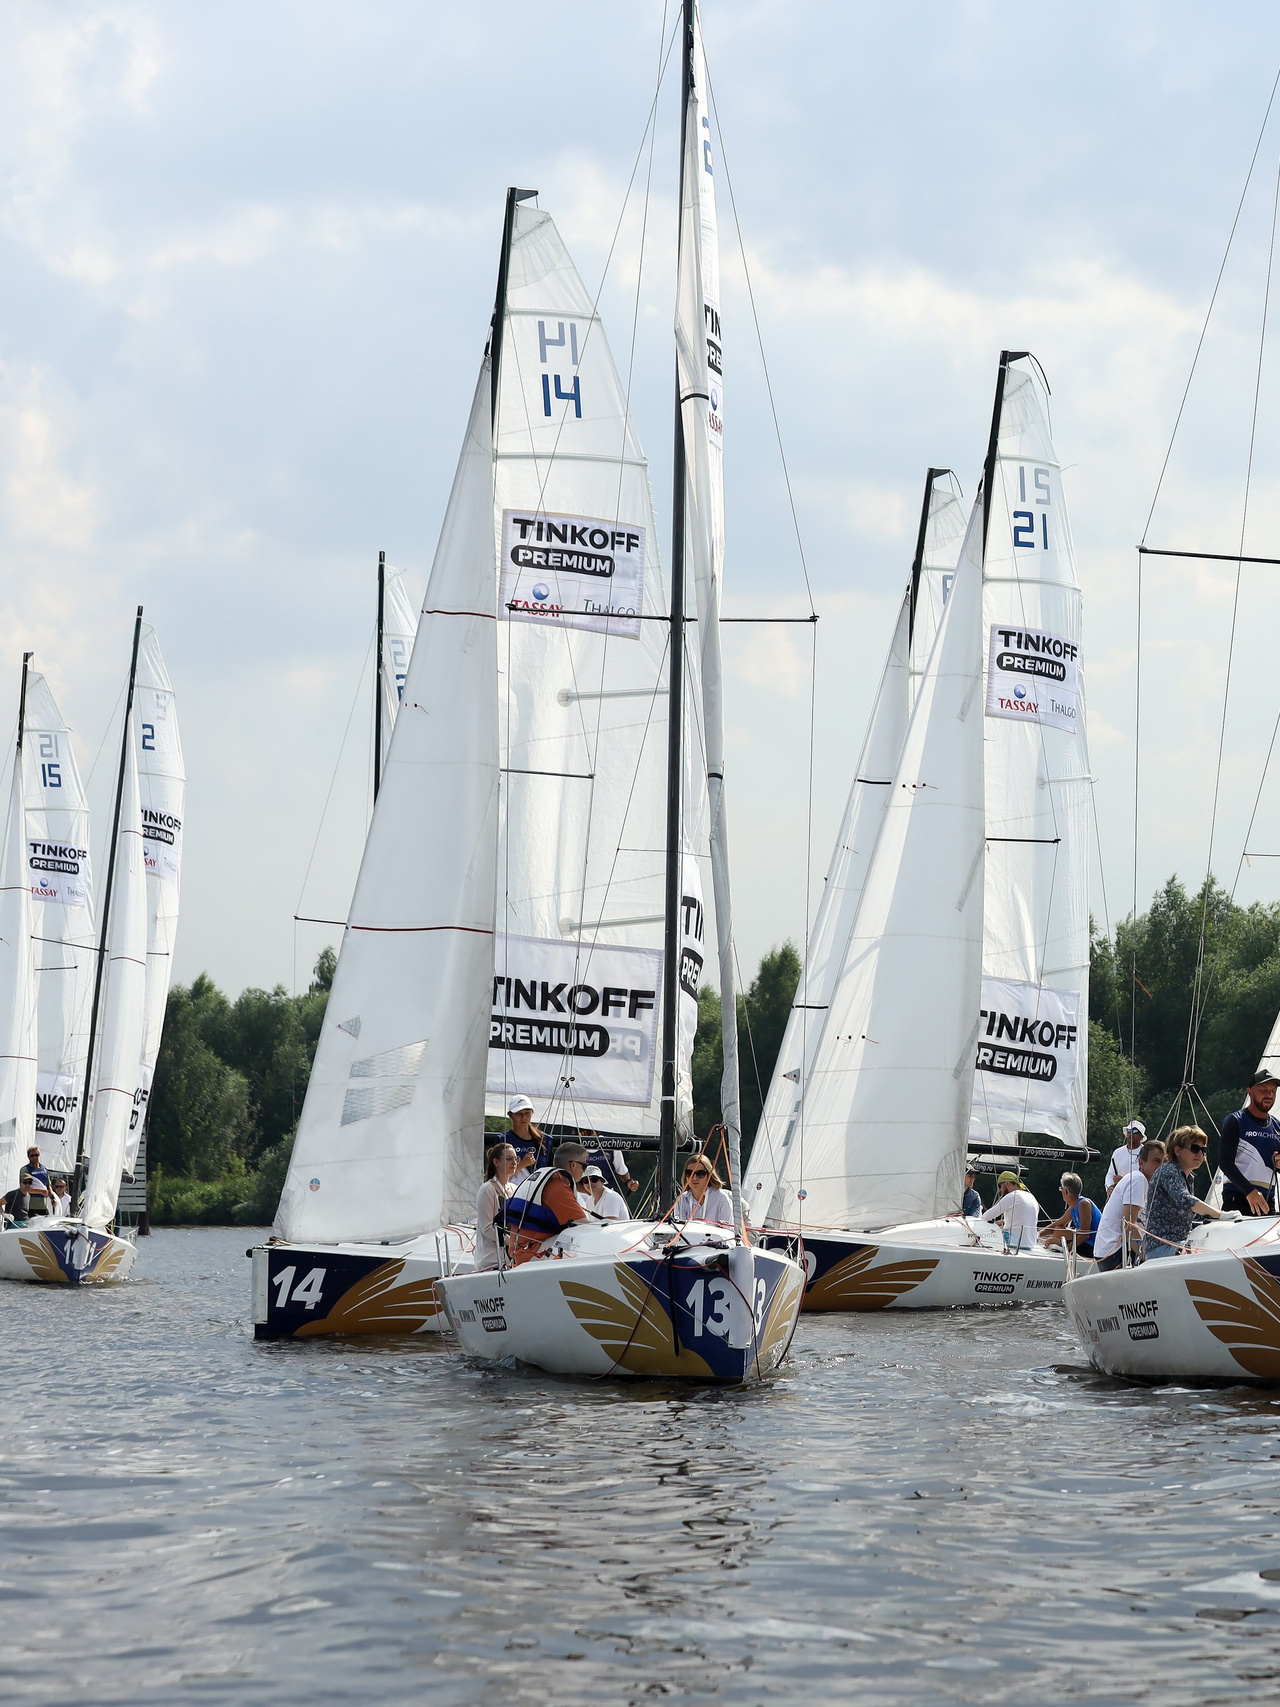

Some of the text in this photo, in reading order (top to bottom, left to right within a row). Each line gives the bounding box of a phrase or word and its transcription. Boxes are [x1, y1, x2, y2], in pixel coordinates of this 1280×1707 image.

[541, 374, 582, 418] 14
[512, 518, 640, 553] TINKOFF
[1013, 510, 1048, 550] 21
[518, 549, 611, 573] PREMIUM
[998, 630, 1078, 662] TINKOFF
[1002, 655, 1064, 678] PREMIUM
[998, 697, 1039, 714] TASSAY
[1050, 699, 1077, 719] THALGO
[142, 723, 155, 751] 2
[41, 763, 62, 788] 15
[141, 809, 182, 832] INKOFF
[143, 828, 174, 844] REMIUM
[29, 843, 87, 860] TINKOFF
[32, 859, 78, 873] PREMIUM
[31, 887, 58, 897] TASSAY
[493, 976, 656, 1018] TINKOFF
[489, 1021, 600, 1051] PREMIUM
[980, 1010, 1077, 1049] INKOFF
[977, 1047, 1053, 1076] REMIUM
[36, 1093, 78, 1113] NKOFF
[582, 1139, 642, 1150] pro-yachting.ru
[272, 1265, 327, 1309] 14
[973, 1271, 1024, 1283] TINKOFF
[976, 1284, 1013, 1293] PREMIUM
[473, 1297, 505, 1314] TINKOFF
[686, 1277, 731, 1337] 13
[1118, 1300, 1158, 1320] TINKOFF
[1129, 1324, 1158, 1338] PREMIUM
